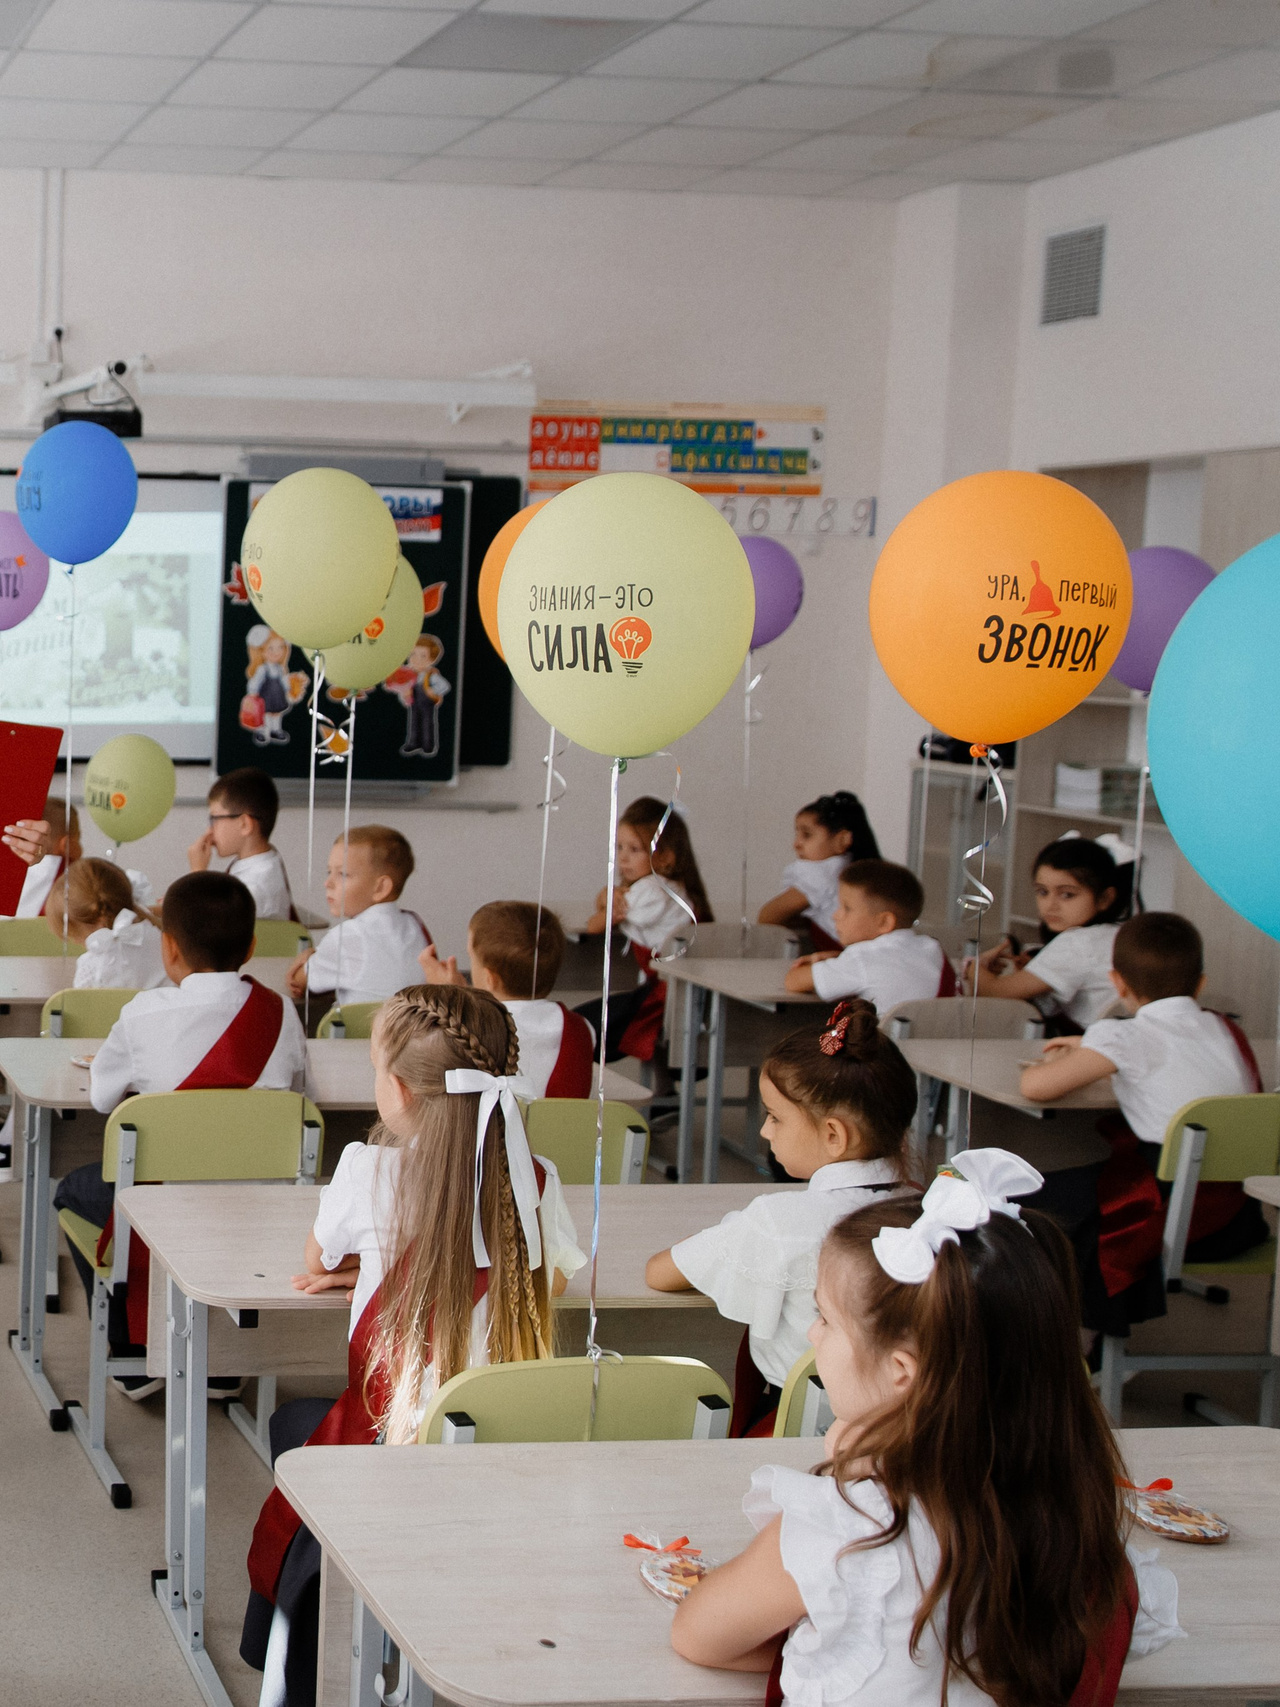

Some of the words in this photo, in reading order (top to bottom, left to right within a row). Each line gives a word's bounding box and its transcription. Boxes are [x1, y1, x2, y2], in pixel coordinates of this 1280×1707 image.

[748, 496, 770, 532] 6
[784, 497, 804, 532] 7
[816, 497, 838, 533] 8
[987, 574, 1026, 602] УРА,
[527, 619, 613, 674] СИЛА
